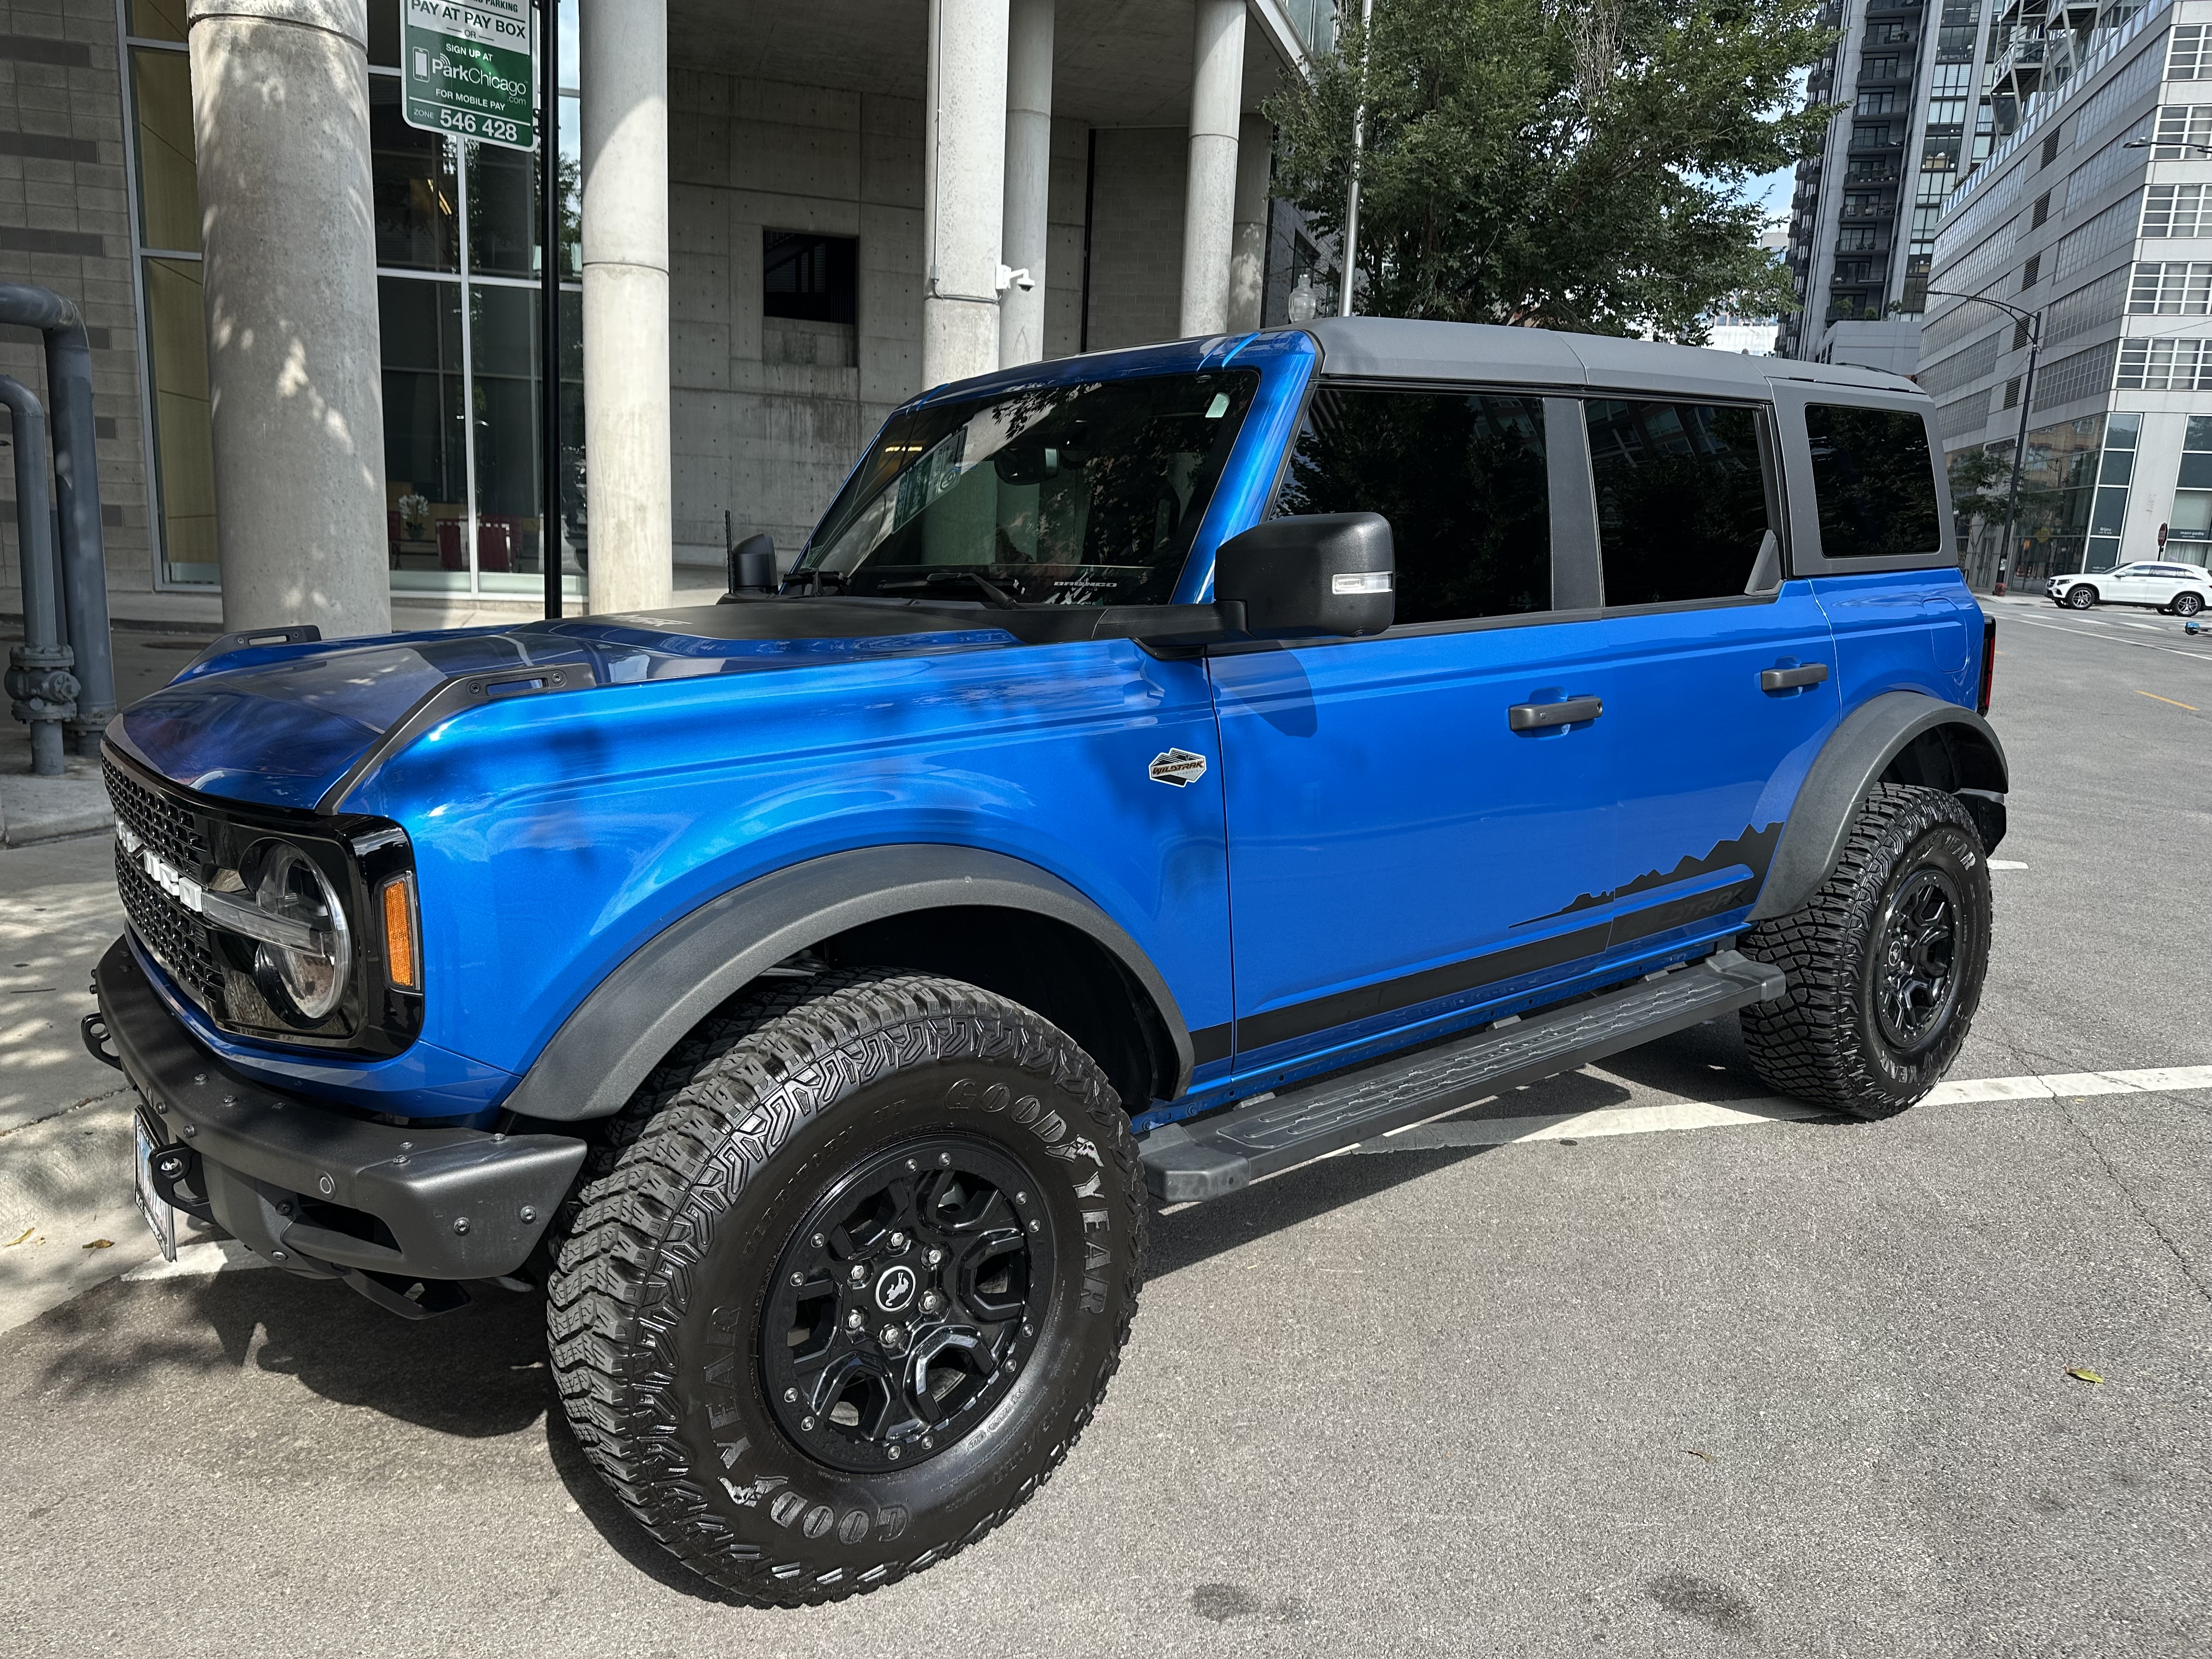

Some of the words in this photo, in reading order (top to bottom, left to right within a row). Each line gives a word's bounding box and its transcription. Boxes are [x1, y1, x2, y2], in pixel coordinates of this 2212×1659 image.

[411, 0, 439, 15] PAY
[442, 7, 460, 21] AT
[465, 12, 491, 29] PAY
[496, 19, 526, 39] BOX
[464, 30, 476, 39] OR
[445, 43, 466, 55] SIGN
[469, 49, 481, 59] UP
[483, 53, 493, 61] AT
[432, 58, 527, 97] ParkChicago
[436, 88, 453, 99] FOR
[455, 92, 488, 108] MOBILE
[490, 101, 505, 111] PAY
[507, 97, 526, 106] .com
[414, 109, 435, 119] ZONE
[440, 109, 476, 133] 546
[482, 119, 517, 142] 428
[1153, 760, 1204, 775] WILDTRAK
[742, 1125, 854, 1256] TERRITORY
